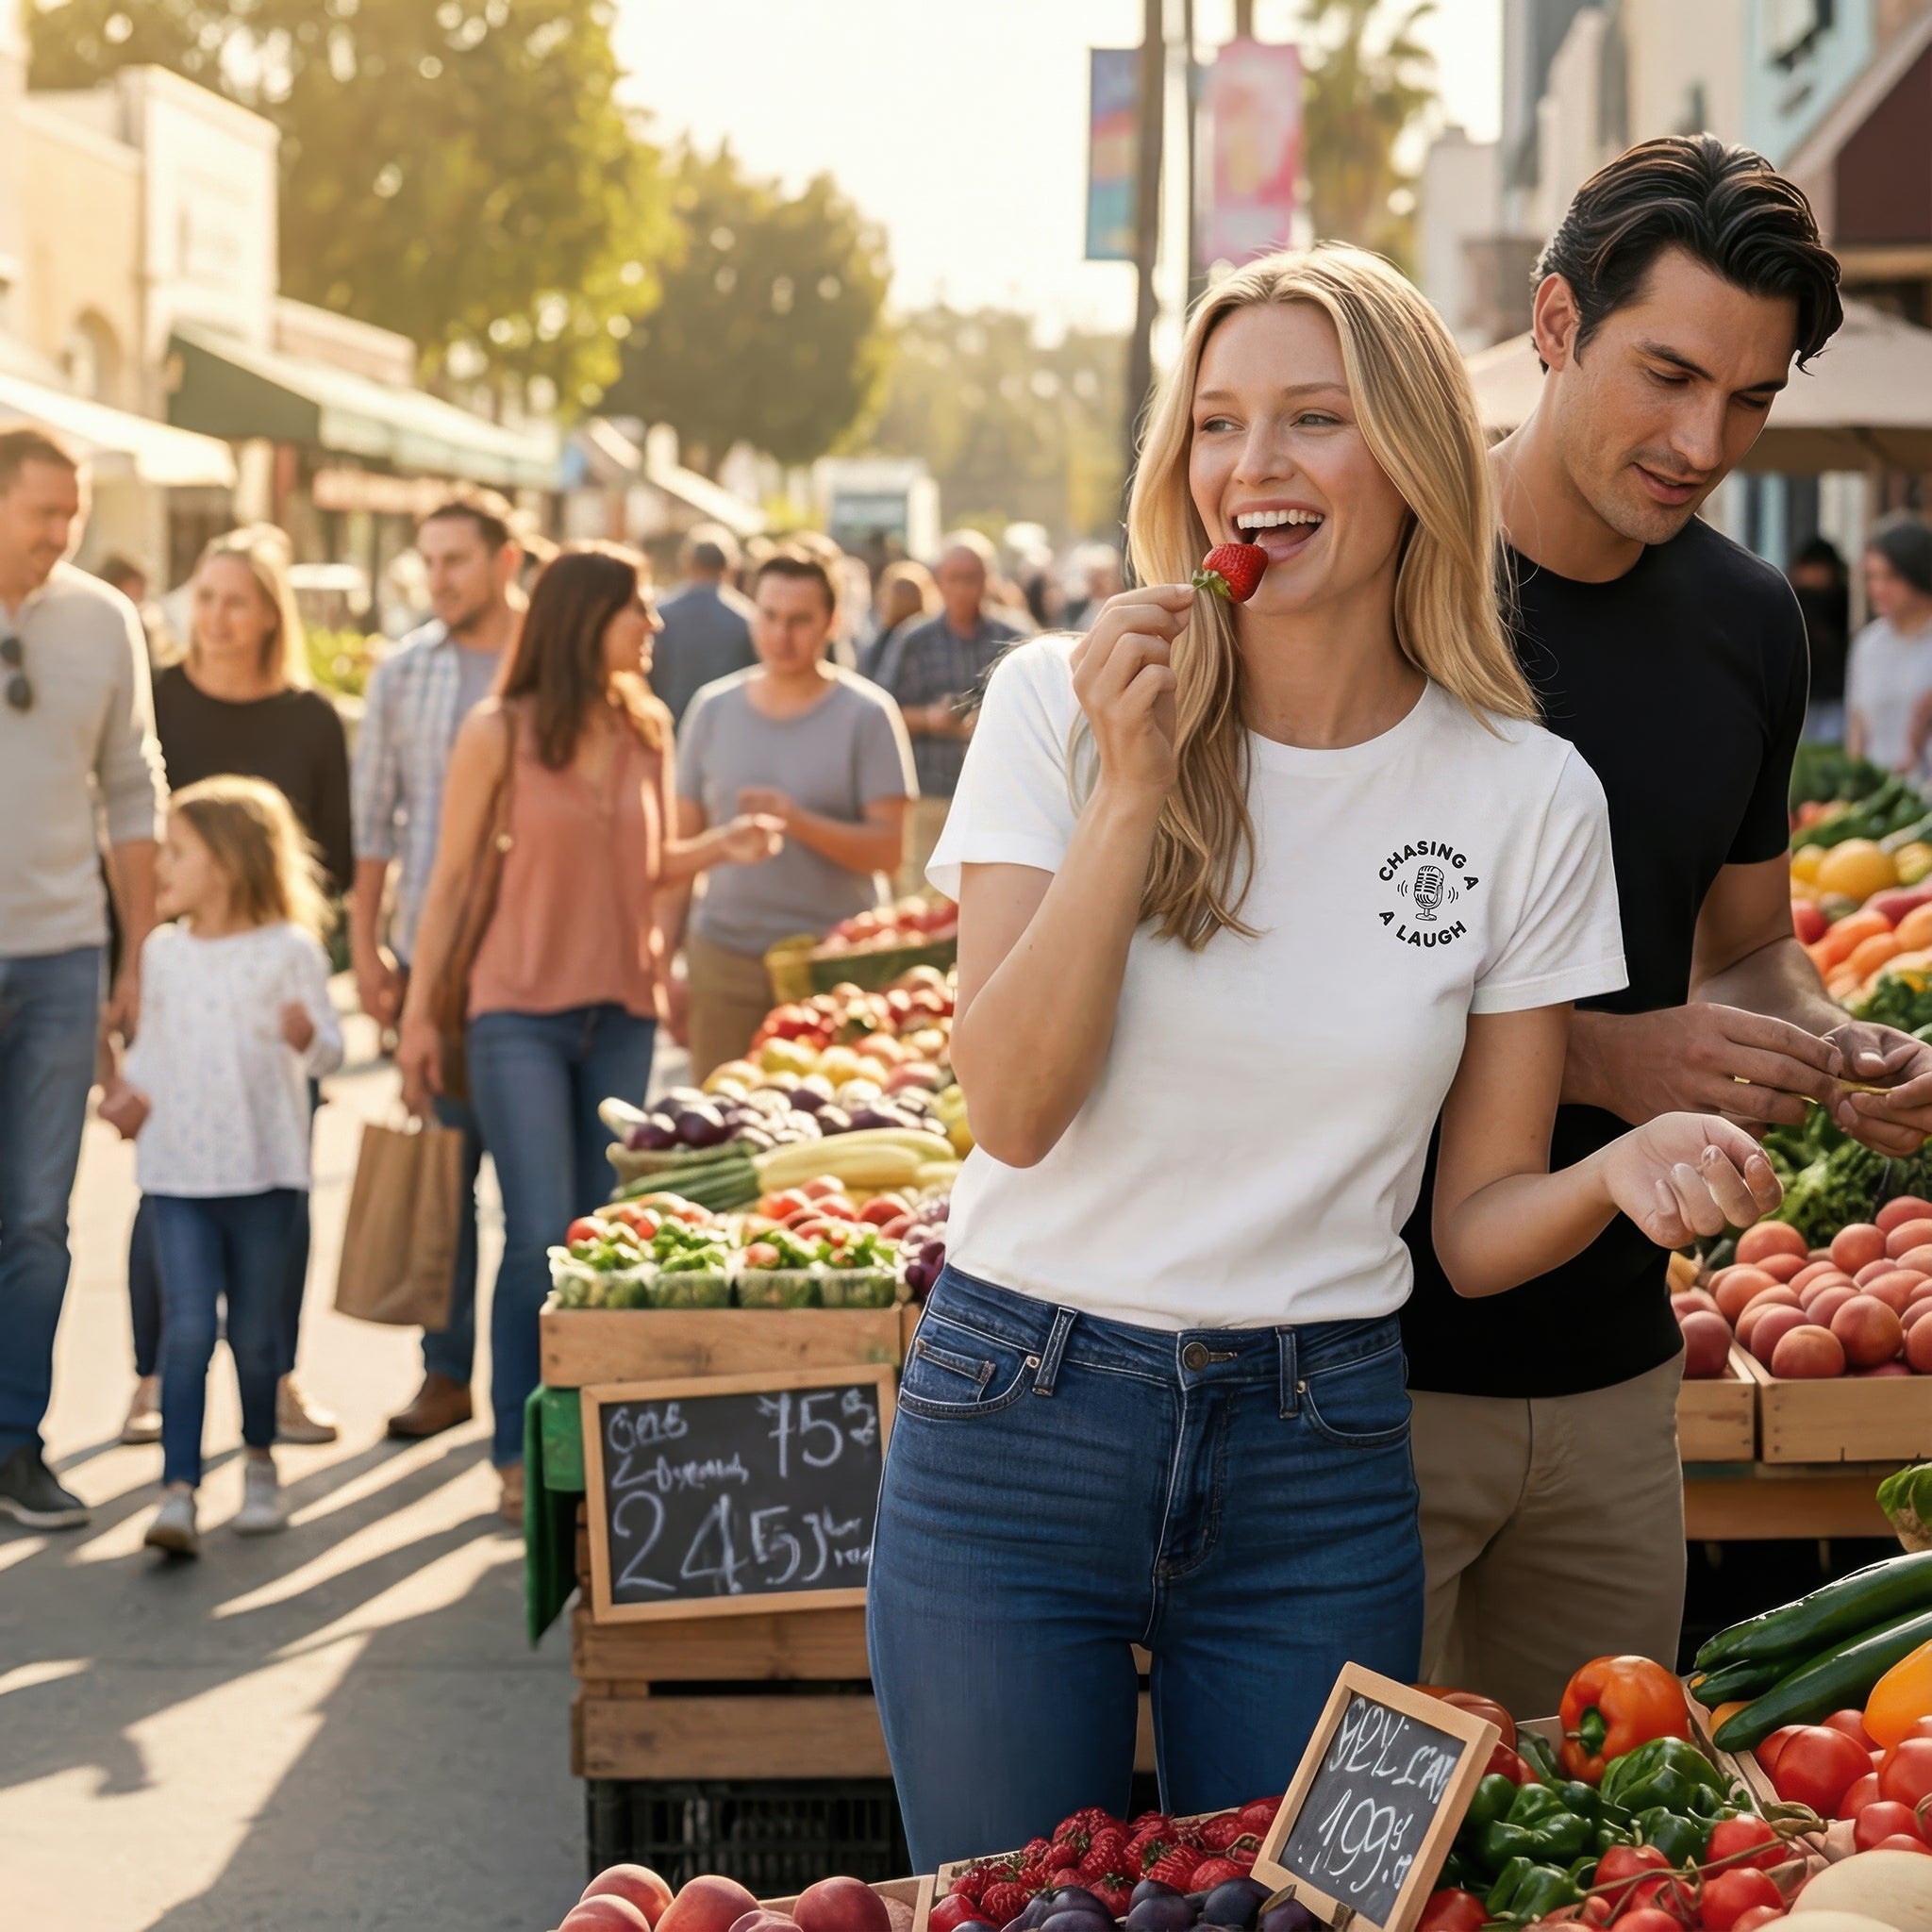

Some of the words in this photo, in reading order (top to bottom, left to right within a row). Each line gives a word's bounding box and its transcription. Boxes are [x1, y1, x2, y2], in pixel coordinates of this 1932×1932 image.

[1378, 841, 1467, 881] CHASING
[1463, 875, 1479, 891] A
[1379, 911, 1395, 926] A
[1396, 920, 1467, 948] LAUGH
